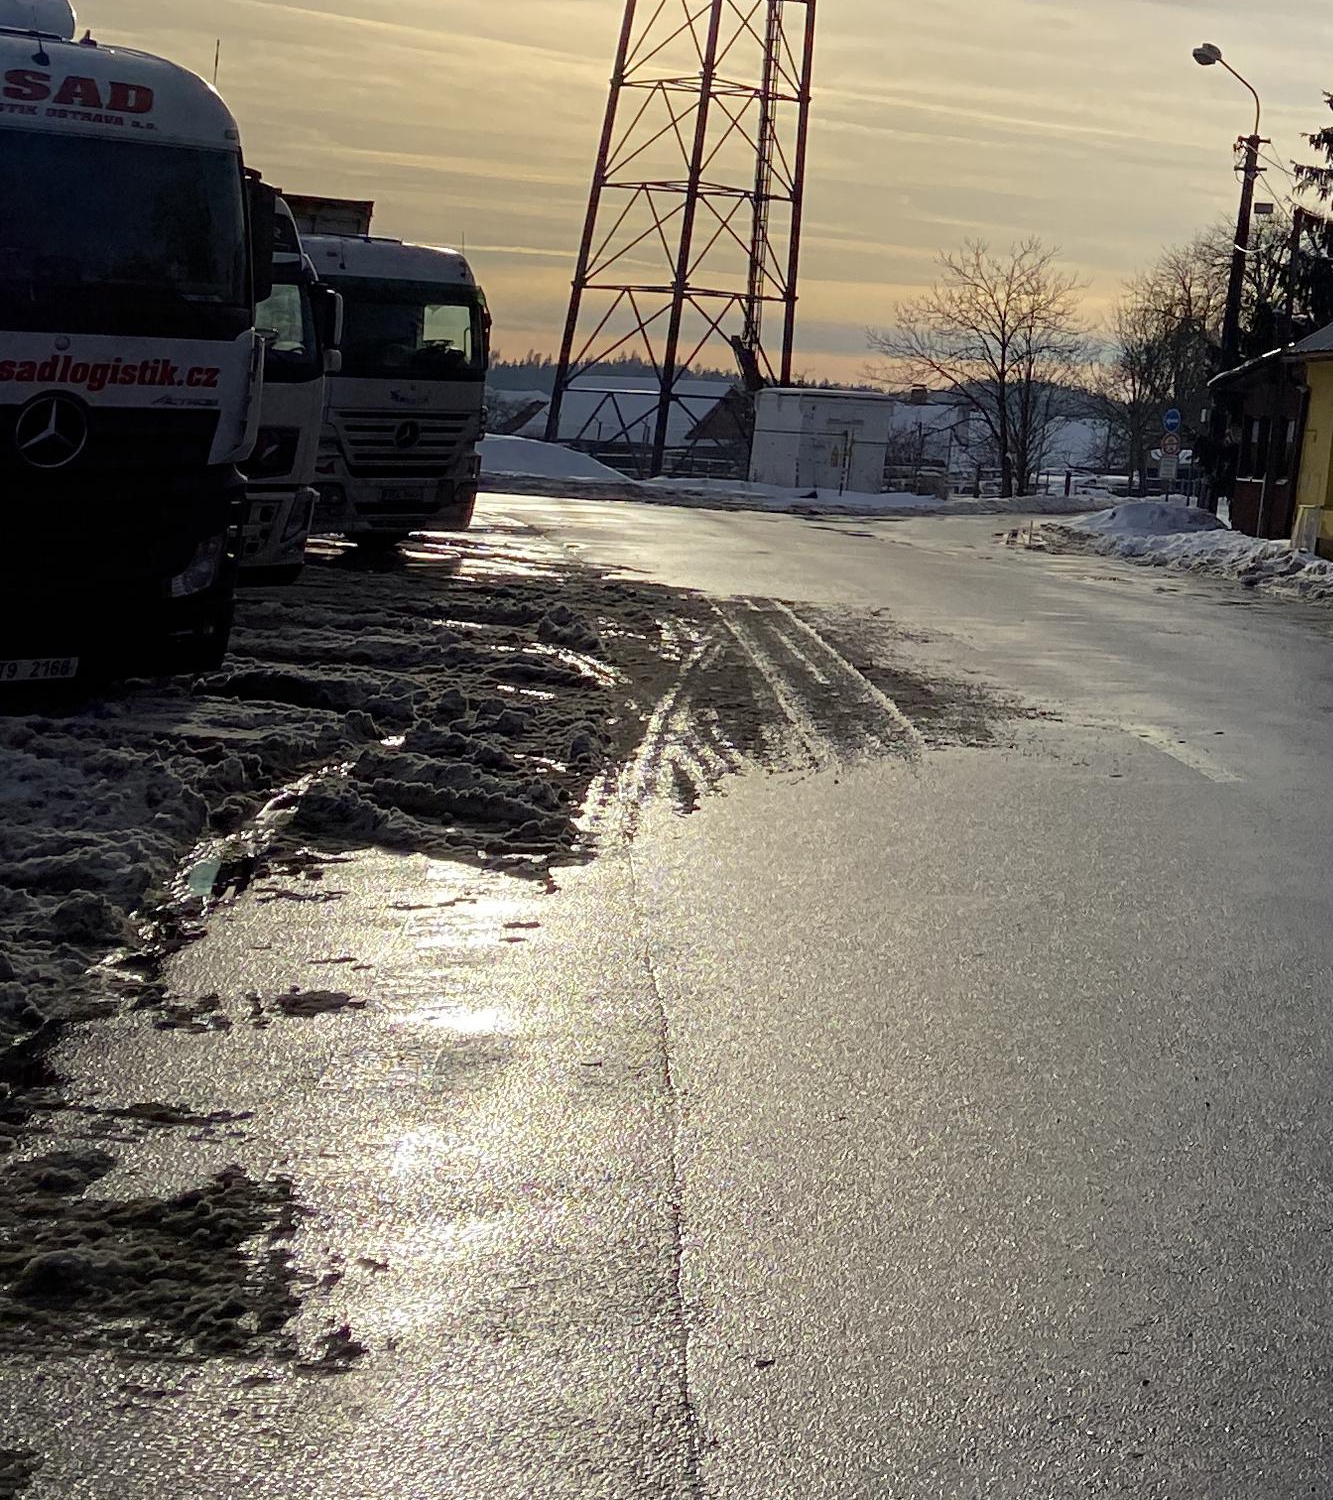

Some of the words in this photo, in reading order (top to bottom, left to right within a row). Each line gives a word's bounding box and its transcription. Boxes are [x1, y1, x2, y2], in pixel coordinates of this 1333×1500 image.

[4, 69, 154, 114] SAD
[46, 108, 124, 126] OSTRAVA
[0, 355, 221, 391] sadlogistik.cz
